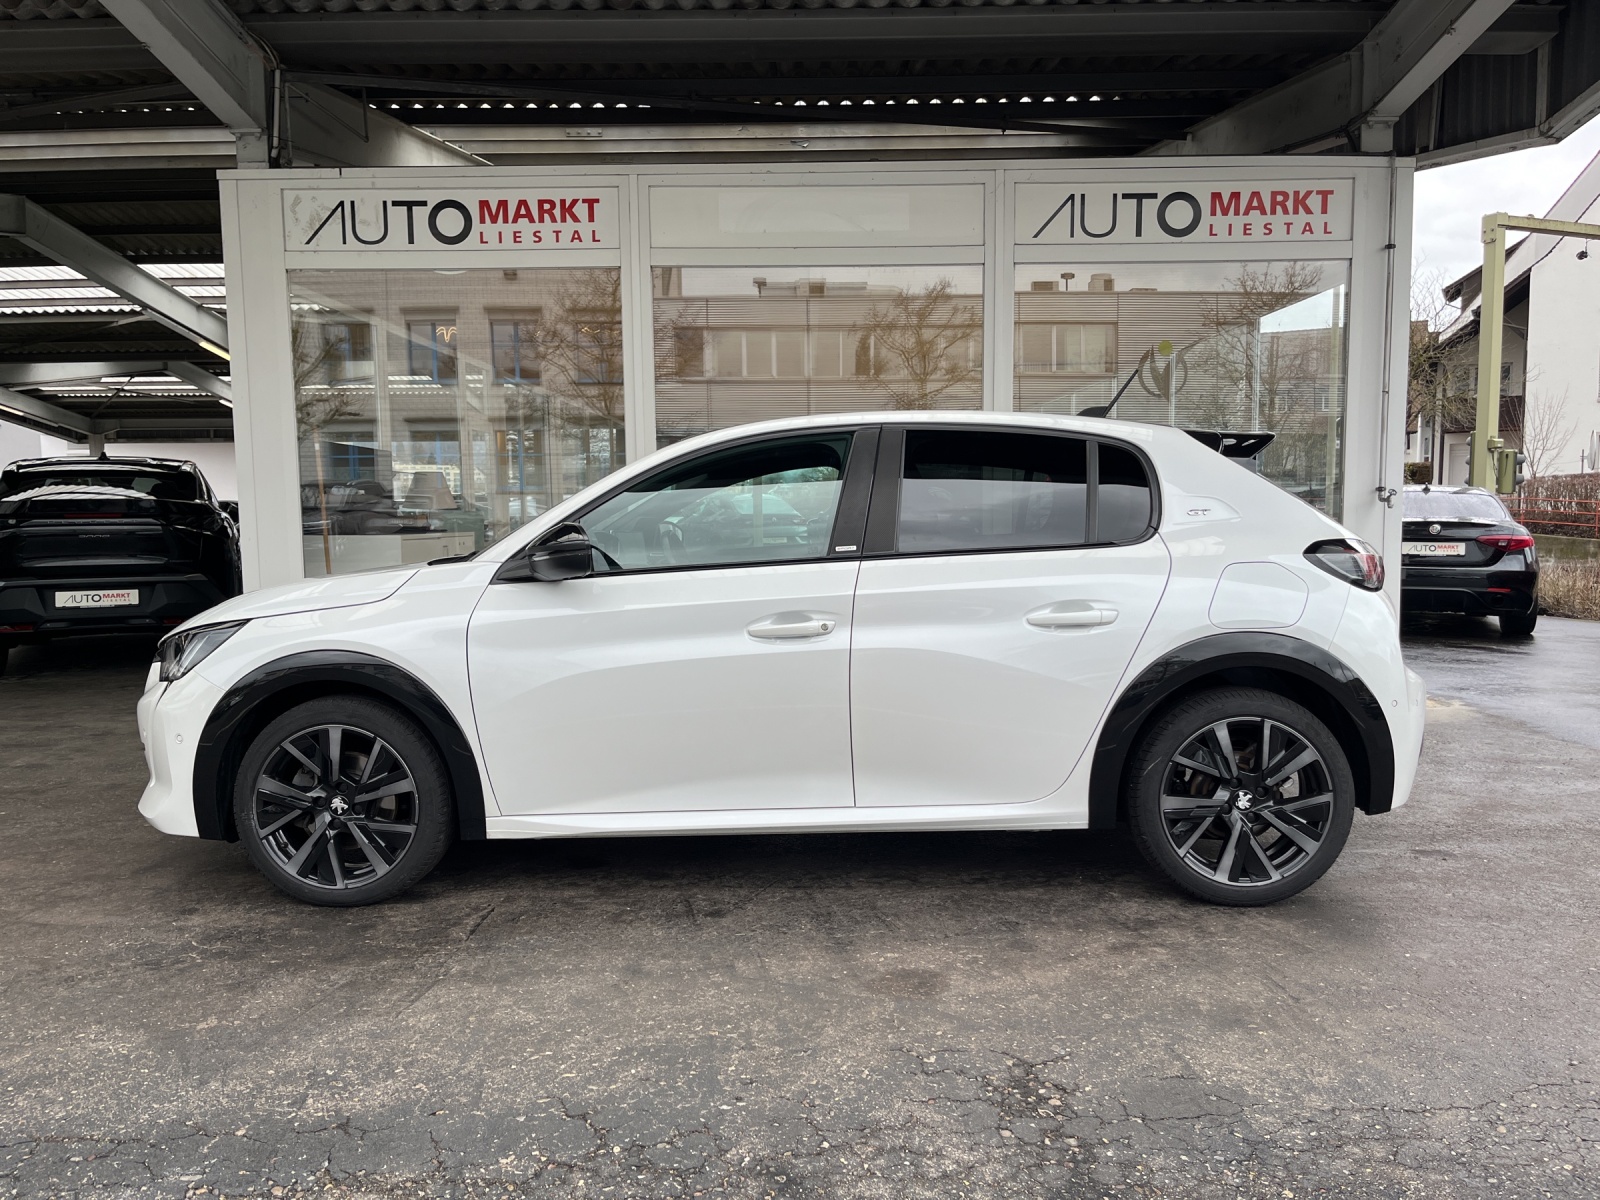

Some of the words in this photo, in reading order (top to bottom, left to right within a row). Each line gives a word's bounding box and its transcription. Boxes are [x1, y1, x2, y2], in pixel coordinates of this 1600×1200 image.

[1031, 191, 1202, 238] AUTO
[1209, 189, 1335, 217] MARKT
[304, 199, 473, 245] AUTO
[478, 198, 600, 225] MARKT
[1209, 221, 1333, 236] LIESTAL
[479, 229, 601, 244] LIESTAL
[1186, 508, 1211, 516] GT
[1408, 544, 1437, 552] AUTO
[64, 593, 102, 604] AUTO
